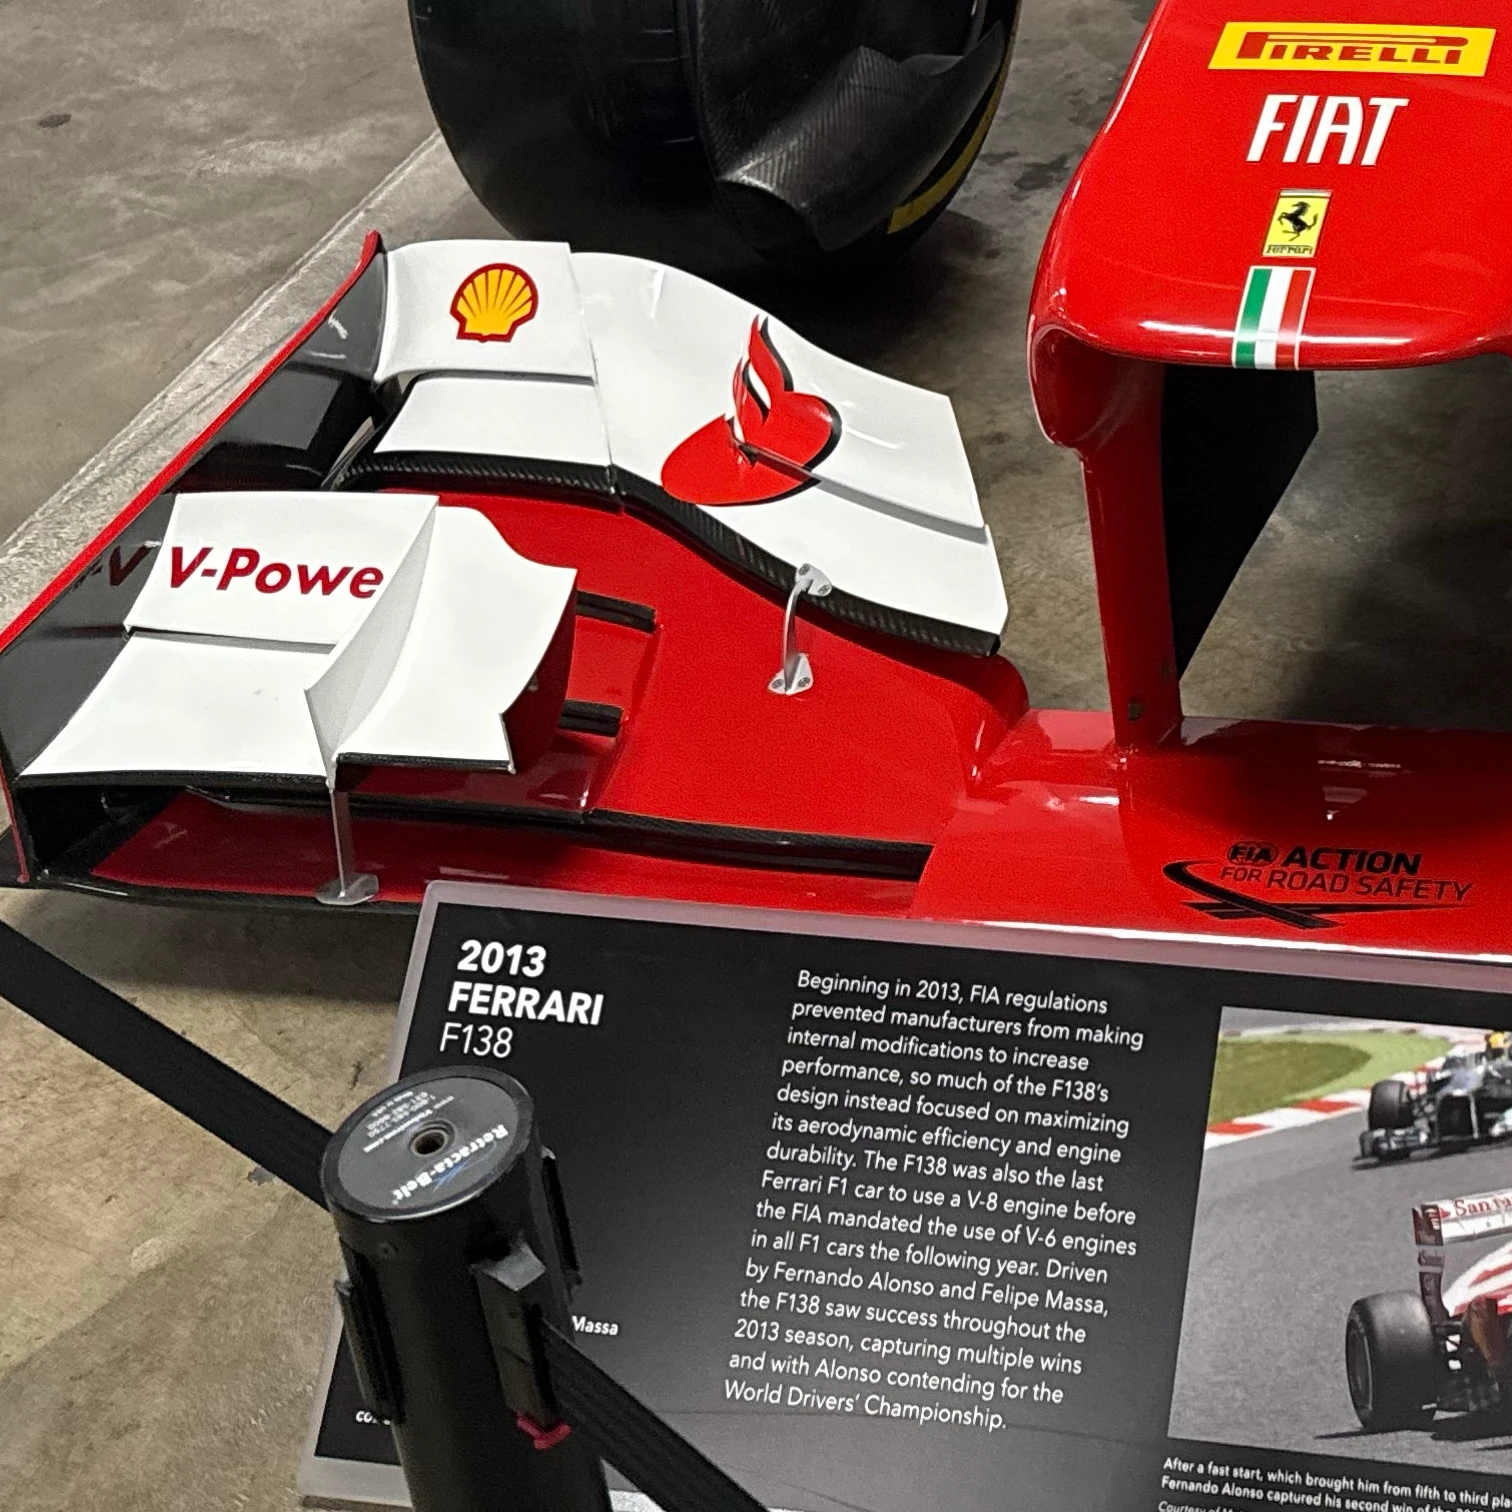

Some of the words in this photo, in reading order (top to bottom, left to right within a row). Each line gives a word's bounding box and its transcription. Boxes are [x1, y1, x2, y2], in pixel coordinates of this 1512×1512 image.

[1236, 31, 1470, 65] PIRELLI
[1246, 94, 1410, 167] FIAT
[169, 545, 384, 599] V-Powe
[1220, 866, 1264, 883] FOR
[1266, 869, 1350, 894] ROAD
[1352, 875, 1473, 902] SAFETY
[1281, 845, 1422, 875] ACTION
[456, 939, 548, 978] 2013
[447, 980, 605, 1027] FERRARI
[797, 969, 890, 1001] Beginning
[894, 977, 911, 997] in
[915, 979, 964, 1005] 2013,
[969, 983, 1001, 1005] FIA
[1005, 989, 1108, 1015] regulations
[438, 1021, 515, 1059] F138
[787, 1025, 857, 1050] internal
[860, 1034, 984, 1062] modifications
[988, 1045, 1008, 1064] to
[1012, 1045, 1090, 1072] increase
[791, 1002, 887, 1024] prevented
[890, 1009, 1022, 1036] manufacturers
[1027, 1016, 1071, 1041] from
[1075, 1023, 1144, 1052] making
[780, 1055, 904, 1087] performance,
[909, 1070, 932, 1086] so
[936, 1070, 988, 1092] much
[992, 1073, 1015, 1094] of
[1016, 1074, 1047, 1097] the
[776, 1081, 839, 1111] design
[843, 1088, 912, 1114] instead
[916, 1094, 991, 1121] focused
[994, 1108, 1019, 1125] on
[1024, 1109, 1130, 1140] maximizing
[771, 1111, 794, 1132] its
[797, 1117, 918, 1144] aerodynamic
[921, 1125, 1012, 1158] efficiency
[1015, 1136, 1052, 1157] and
[1056, 1142, 1122, 1166] engine
[766, 1139, 857, 1172] durability.
[863, 1149, 898, 1172] The
[903, 1153, 948, 1177] F138
[952, 1163, 988, 1181] was
[991, 1161, 1030, 1185] also
[1034, 1165, 1066, 1189] the
[1070, 1168, 1105, 1192] last
[761, 1168, 824, 1194] Ferrari
[827, 1175, 848, 1196] F1
[854, 1183, 885, 1200] car
[888, 1184, 908, 1203] to
[912, 1189, 945, 1207] use
[949, 1193, 961, 1208] a
[967, 1189, 998, 1212] V-8
[1003, 1197, 1068, 1221] engine
[1073, 1199, 1137, 1226] before
[756, 1198, 787, 1220] the
[791, 1201, 822, 1224] FIA
[827, 1209, 923, 1234] mandated
[927, 1215, 958, 1238] the
[963, 1224, 996, 1242] use
[1000, 1223, 1023, 1244] of
[1025, 1225, 1057, 1248] V-6
[1061, 1233, 1137, 1258] engines
[750, 1228, 768, 1249] in
[772, 1230, 795, 1251] all
[799, 1232, 820, 1254] F1
[826, 1241, 865, 1259] cars
[869, 1239, 900, 1262] the
[905, 1242, 991, 1277] following
[994, 1258, 1039, 1279] year.
[1045, 1257, 1108, 1284] Driven
[745, 1256, 770, 1284] by
[773, 1260, 864, 1289] Fernando
[867, 1271, 935, 1297] Alonso
[939, 1280, 977, 1301] and
[981, 1282, 1040, 1311] Felipe
[1044, 1288, 1109, 1318] Massa,
[571, 1315, 619, 1336] Massa
[740, 1287, 771, 1310] the
[775, 1291, 821, 1316] F138
[824, 1302, 862, 1319] saw
[865, 1306, 938, 1328] success
[943, 1308, 1051, 1341] throughout
[1055, 1320, 1087, 1344] the
[733, 1317, 780, 1342] 2013
[784, 1328, 854, 1353] season,
[860, 1337, 952, 1366] capturing
[956, 1343, 1035, 1372] multiple
[1040, 1352, 1082, 1375] wins
[728, 1350, 767, 1372] and
[771, 1354, 810, 1376] with
[814, 1358, 882, 1384] Alonso
[886, 1370, 995, 1402] contending
[1000, 1376, 1029, 1400] for
[1032, 1380, 1064, 1405] the
[724, 1379, 783, 1404] World
[864, 1394, 1007, 1433] Championship.
[1161, 1474, 1219, 1495] Fernando
[1221, 1482, 1264, 1500] Alonso
[1266, 1490, 1322, 1507] captured
[1324, 1493, 1342, 1509] his
[1344, 1498, 1390, 1512] second
[1162, 1456, 1195, 1473] After
[1196, 1463, 1205, 1474] a
[1207, 1460, 1230, 1477] fast
[1232, 1466, 1263, 1482] start,
[1267, 1468, 1303, 1485] which
[1305, 1472, 1355, 1493] brought
[1357, 1477, 1380, 1494] him
[1383, 1480, 1412, 1498] from
[1414, 1483, 1441, 1501] fifth
[1443, 1489, 1457, 1503] to
[1459, 1489, 1489, 1507] third
